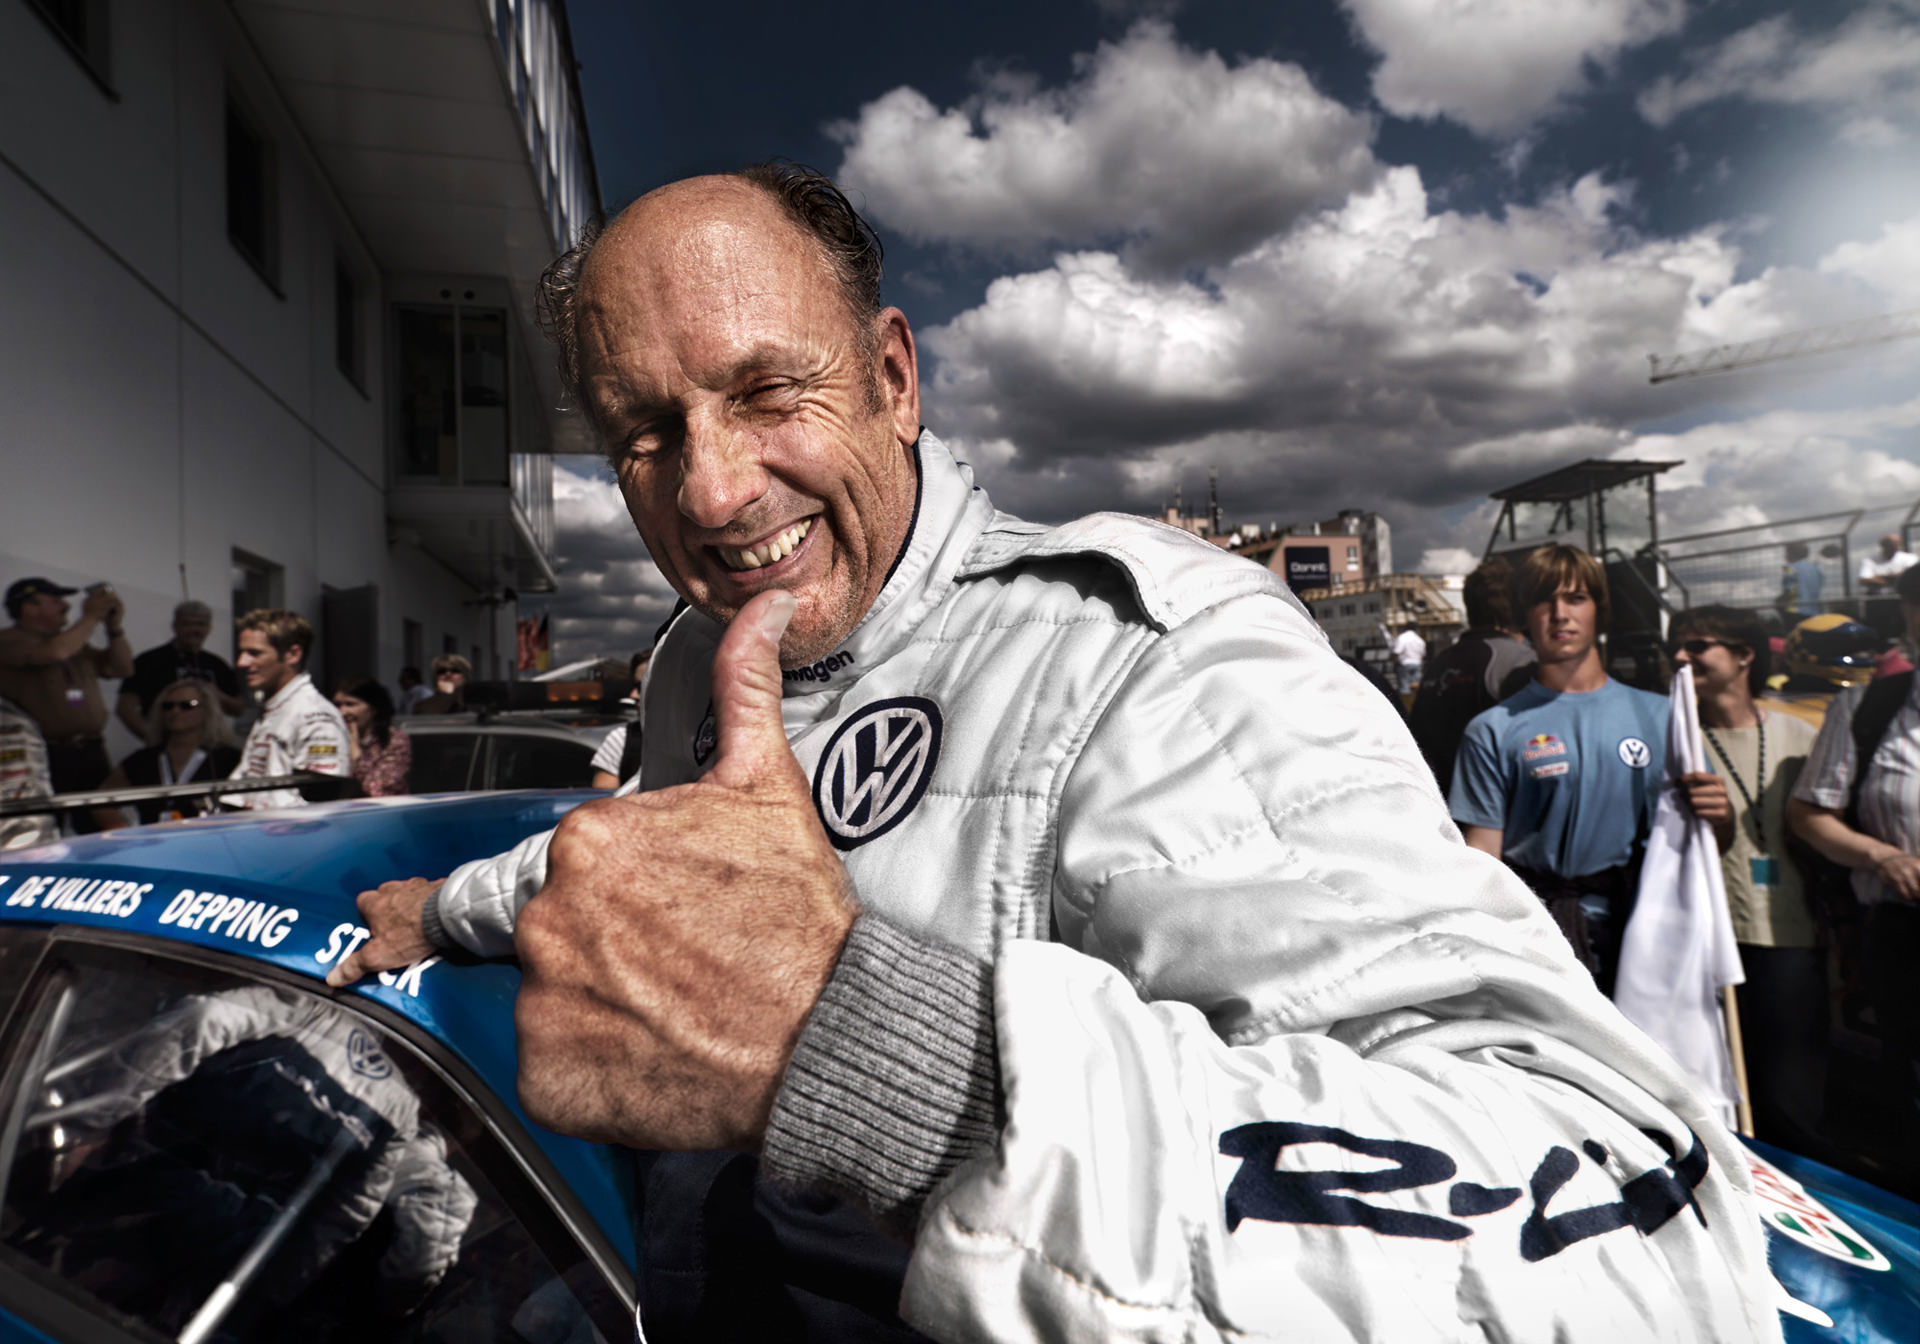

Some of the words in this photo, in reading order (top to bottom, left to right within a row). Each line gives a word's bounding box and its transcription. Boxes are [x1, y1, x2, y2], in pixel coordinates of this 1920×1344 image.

[781, 650, 855, 683] wagen
[158, 889, 299, 949] DEPPING
[315, 922, 444, 998] STK
